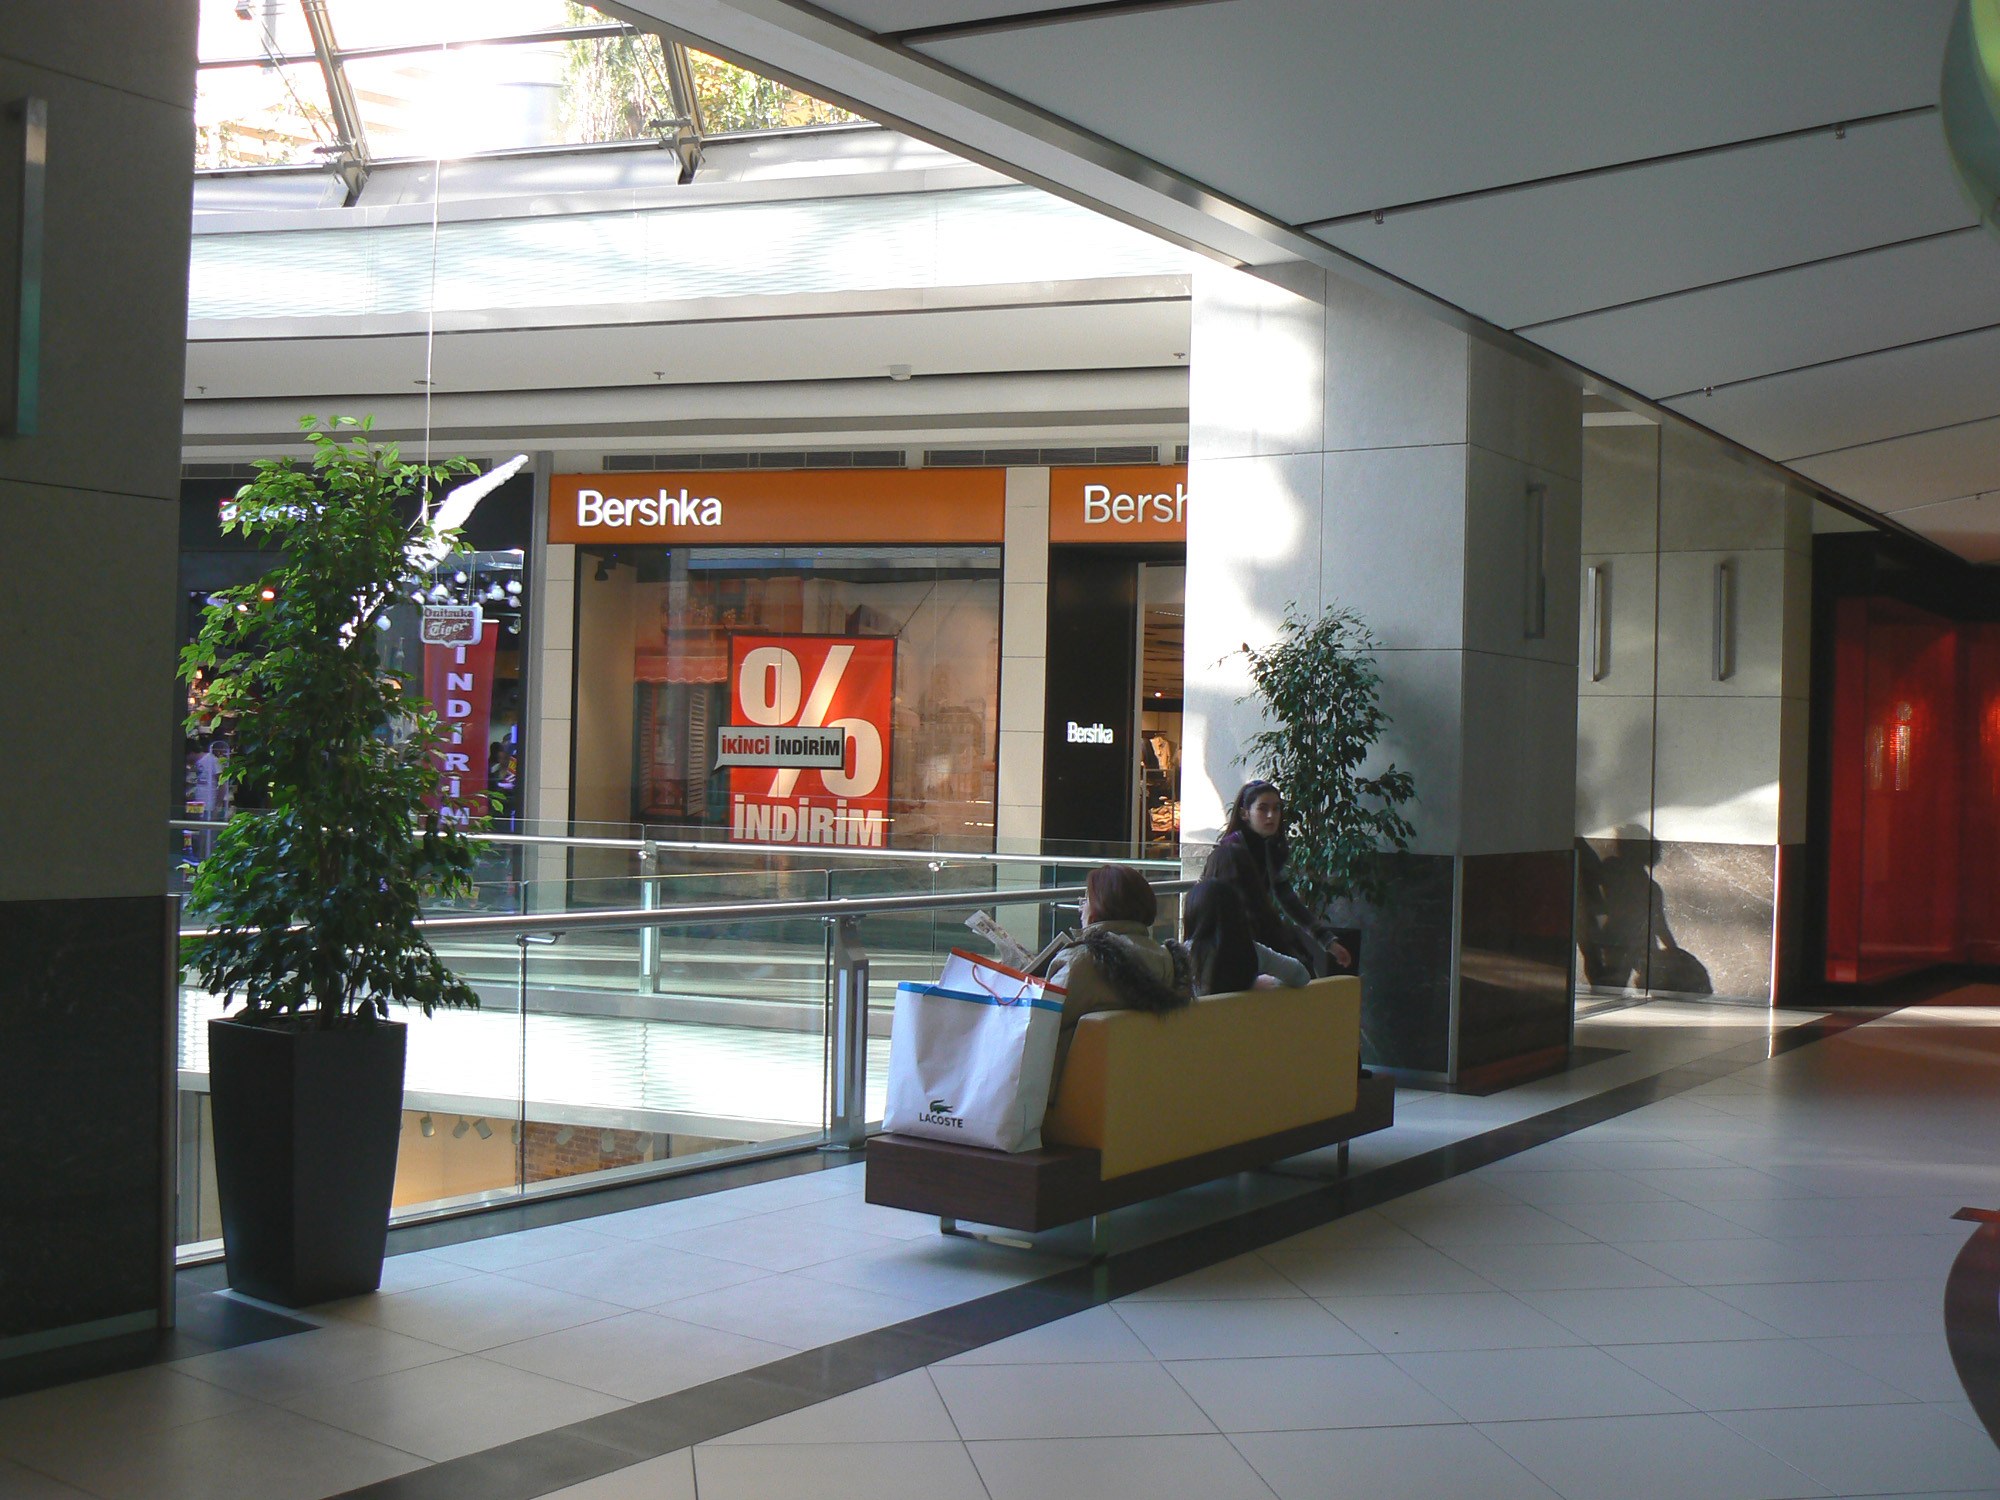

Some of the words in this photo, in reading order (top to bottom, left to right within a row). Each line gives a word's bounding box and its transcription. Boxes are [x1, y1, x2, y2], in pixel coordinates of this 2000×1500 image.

[577, 488, 722, 527] Bershka
[424, 608, 474, 618] Onitsuka
[429, 621, 470, 637] Tiger
[1067, 721, 1114, 744] Bershka
[722, 735, 770, 755] İKİNCİ
[775, 735, 840, 756] İNDİRİM
[733, 794, 883, 847] İNDİRİM
[919, 1112, 963, 1128] LACOSTE
